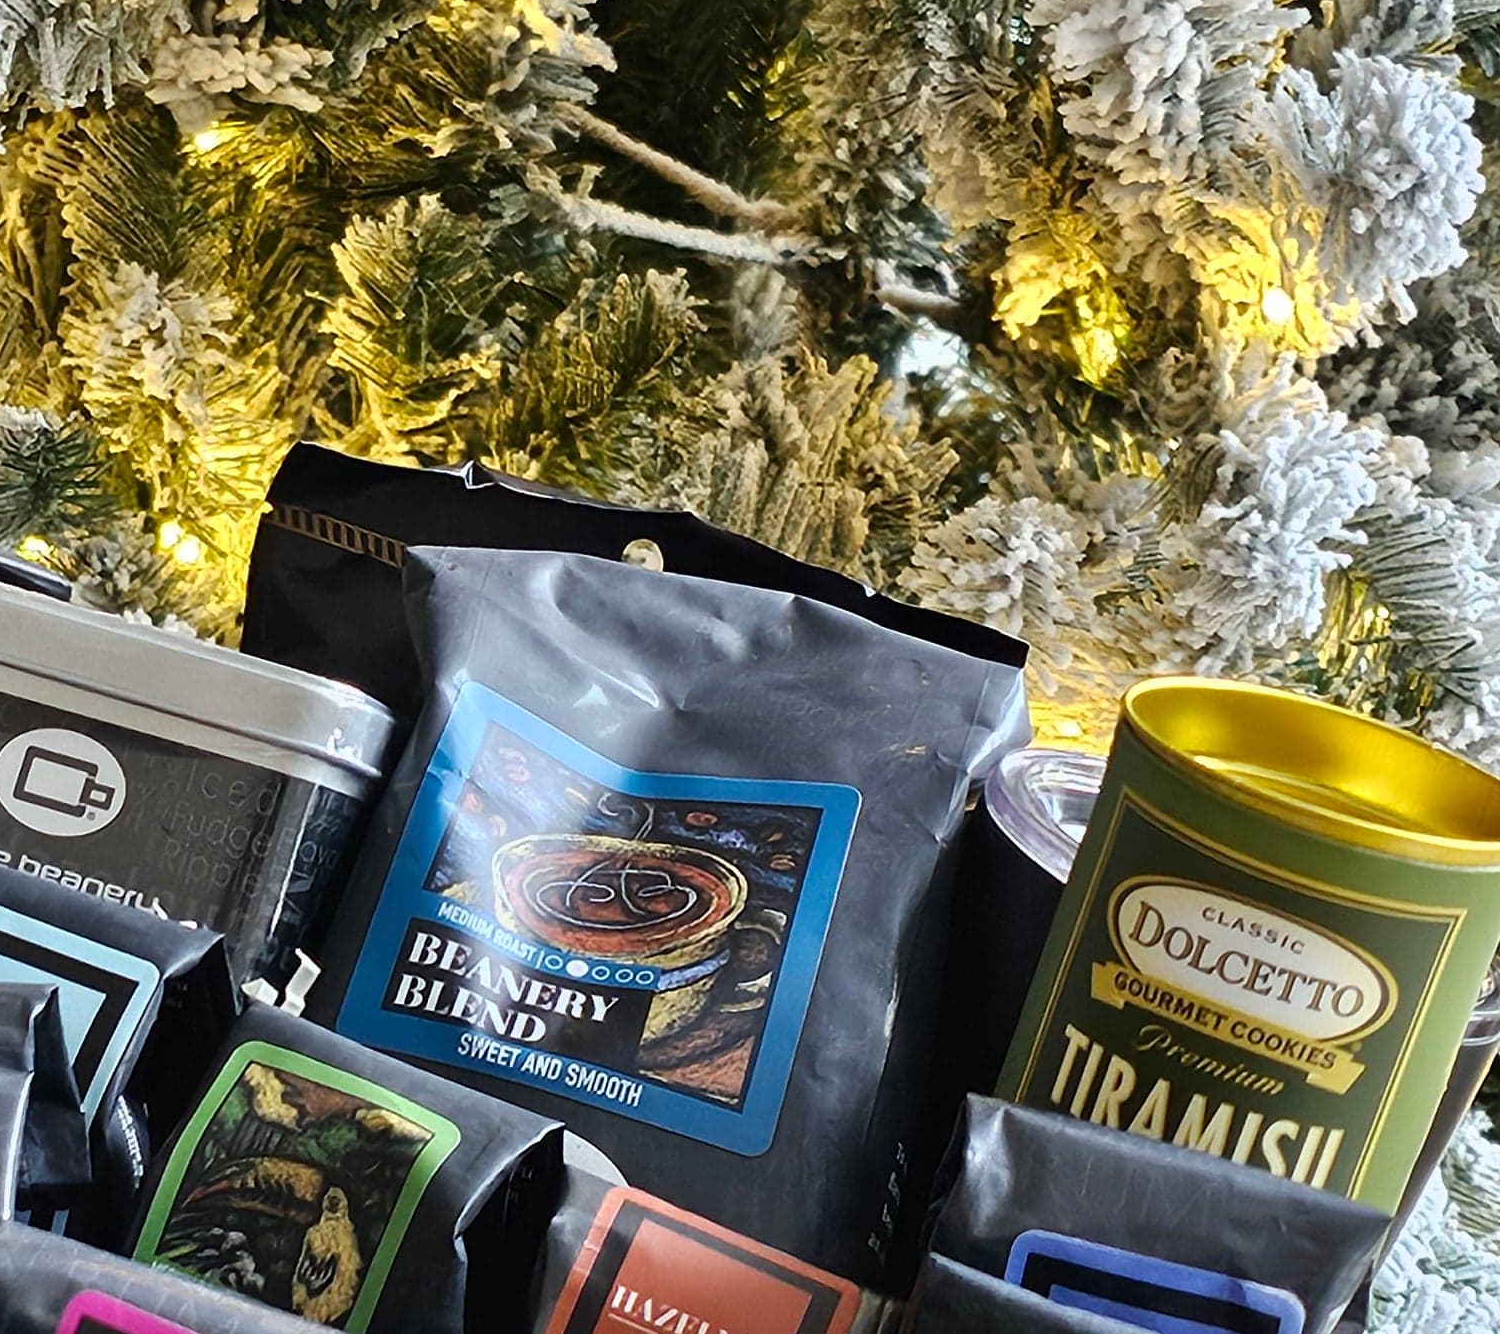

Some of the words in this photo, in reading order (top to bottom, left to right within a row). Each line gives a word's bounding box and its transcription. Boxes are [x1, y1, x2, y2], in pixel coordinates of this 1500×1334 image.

[17, 853, 164, 913] beanery
[437, 901, 495, 942] MEDIUM
[494, 927, 537, 961] ROAST
[1129, 900, 1366, 1020] DOLCETTO
[1201, 906, 1306, 957] CLASSIC
[393, 972, 547, 1044] BLEND
[408, 930, 620, 1023] BEANERY
[1113, 968, 1230, 1033] GOURMET
[1230, 1020, 1339, 1073] COOKIES
[457, 1033, 521, 1068] SWEET
[520, 1051, 562, 1081] AND
[564, 1062, 644, 1109] SMOOTH
[1133, 1023, 1286, 1098] Premium
